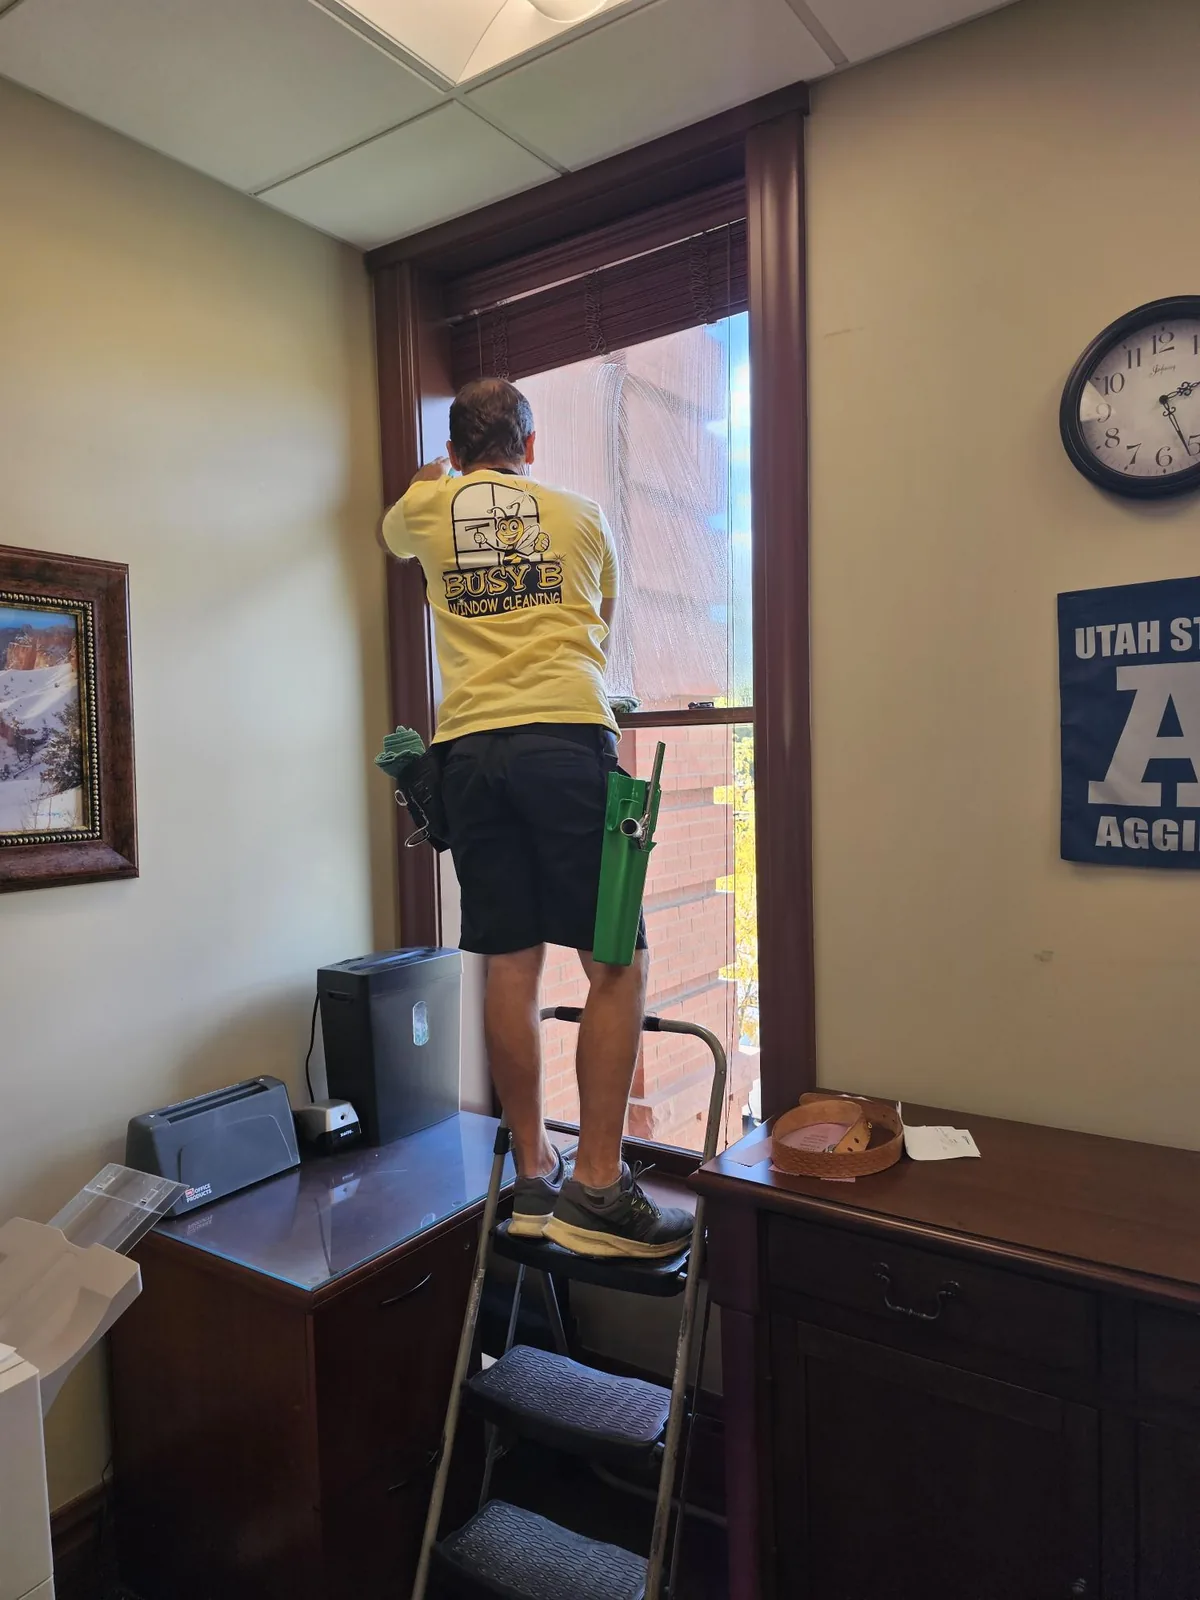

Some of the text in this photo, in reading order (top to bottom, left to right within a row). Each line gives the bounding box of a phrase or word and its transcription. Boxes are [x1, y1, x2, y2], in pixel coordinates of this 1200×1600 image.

[1152, 331, 1175, 355] 12
[1127, 347, 1141, 369] 11
[1103, 372, 1125, 395] 10
[1096, 403, 1112, 423] 9
[1105, 427, 1121, 448] 8
[1126, 443, 1142, 465] 7
[1155, 446, 1173, 467] 6
[442, 563, 563, 599] BUSY B
[450, 591, 561, 616] WINDOW CLEANING
[1075, 620, 1160, 660] UTAH
[1088, 661, 1200, 807] A
[1095, 815, 1200, 852] AGGI
[187, 1189, 212, 1202] PRODUCTS
[194, 1183, 211, 1192] OFFICE
